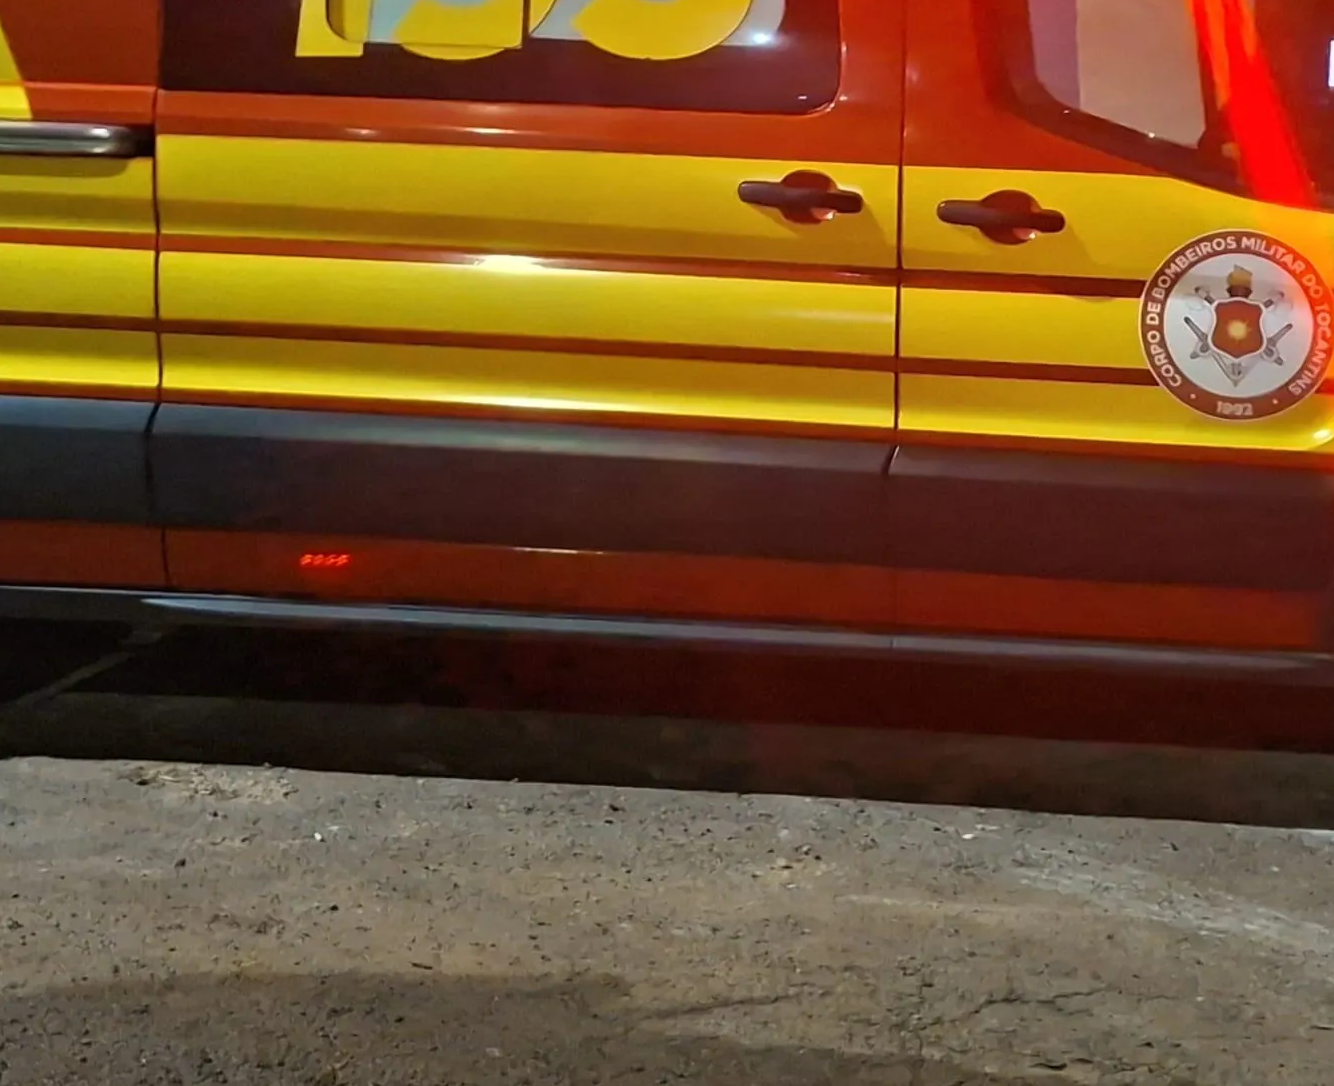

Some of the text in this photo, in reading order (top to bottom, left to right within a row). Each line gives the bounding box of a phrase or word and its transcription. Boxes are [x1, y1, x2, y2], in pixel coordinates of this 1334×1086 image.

[1146, 236, 1332, 396] CORPO DE BOMBEIROS MILITAR DO TOCANTINS
